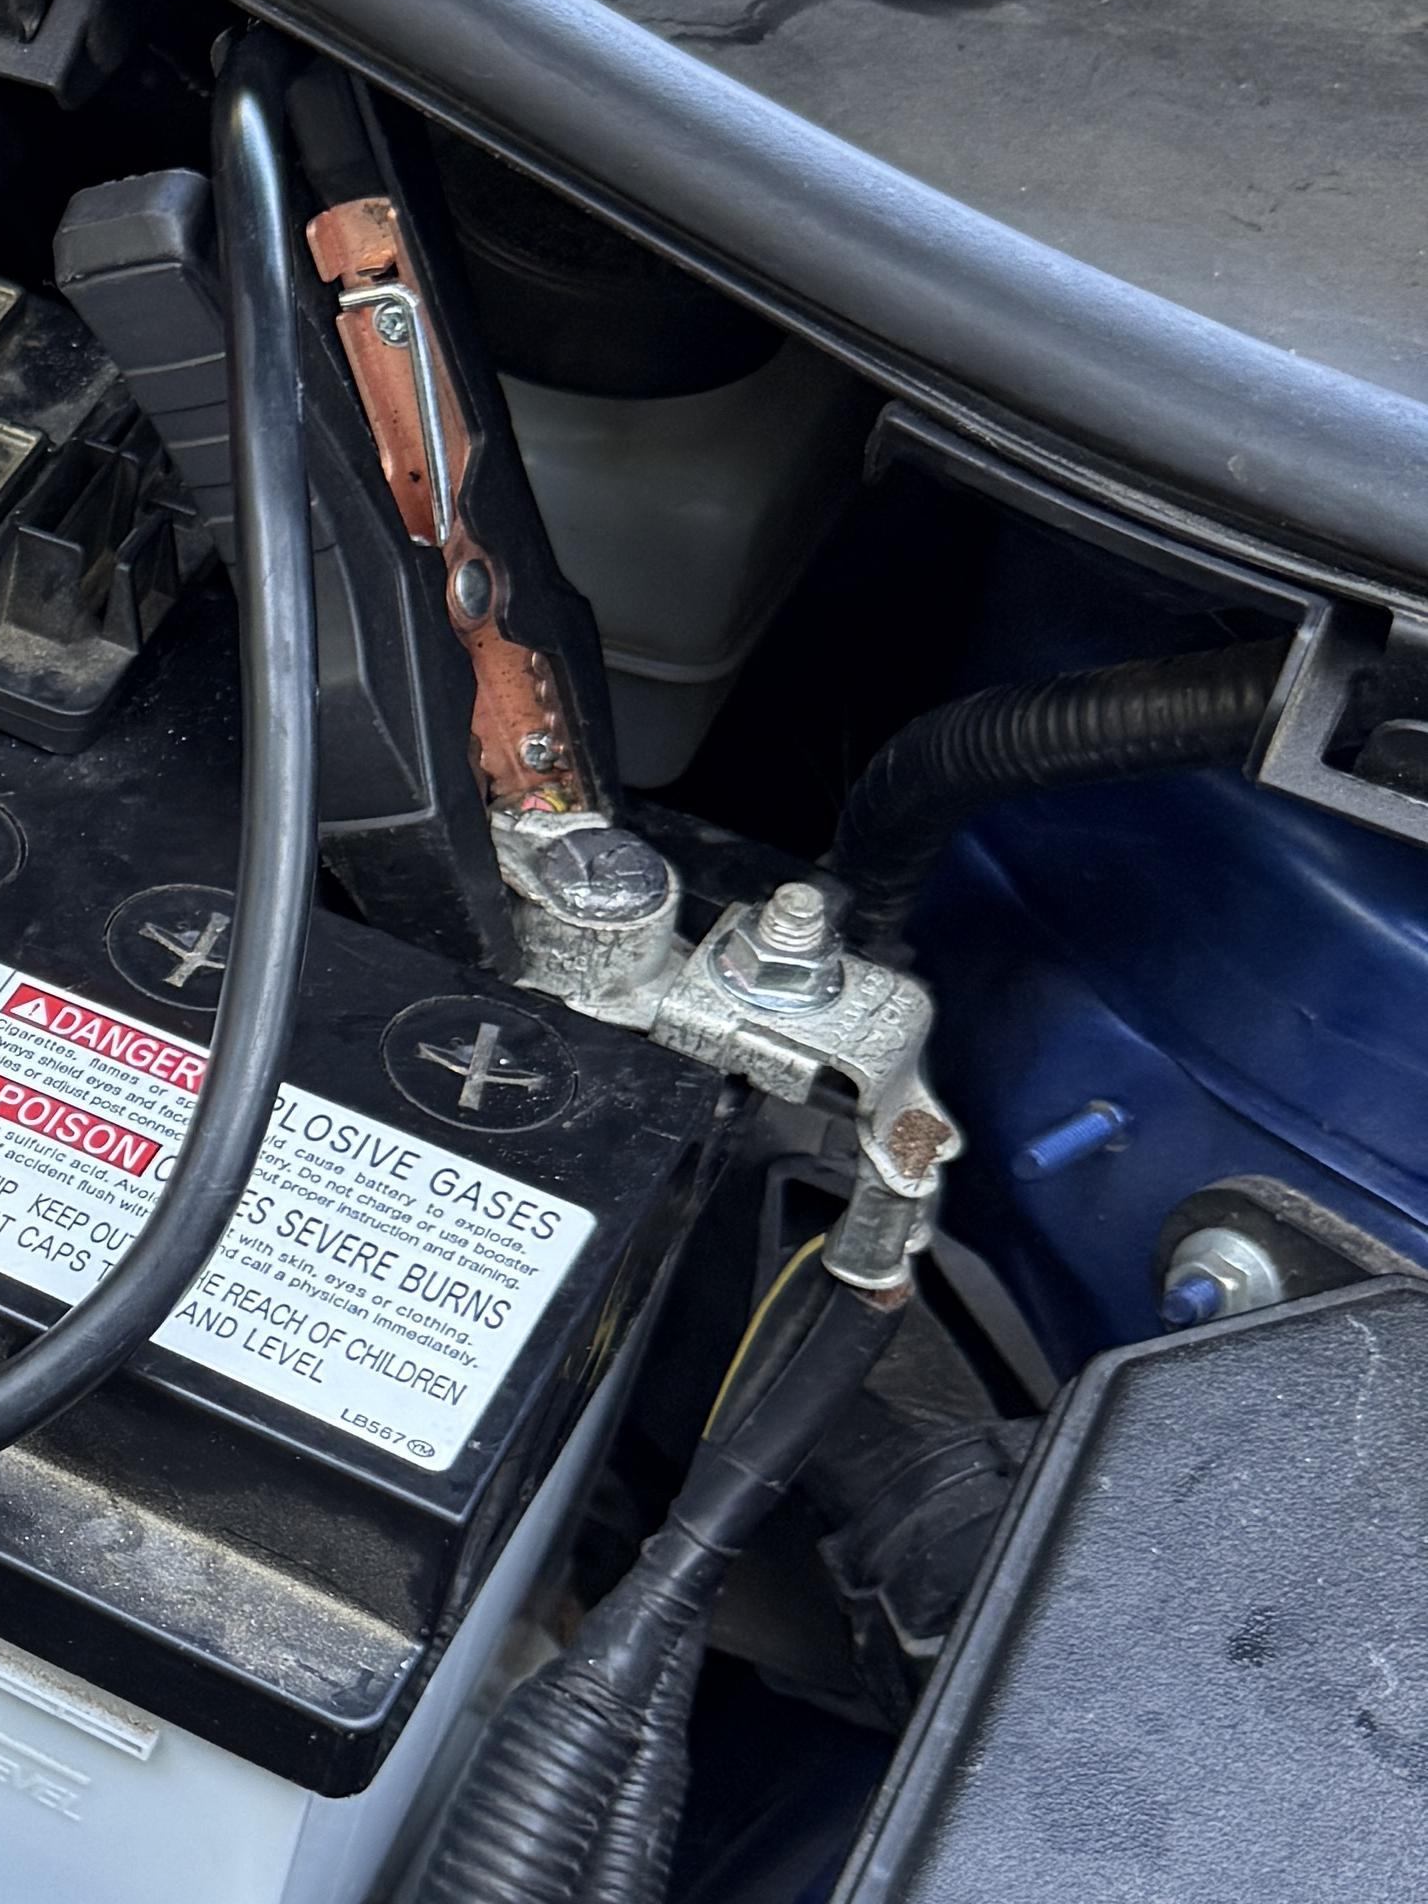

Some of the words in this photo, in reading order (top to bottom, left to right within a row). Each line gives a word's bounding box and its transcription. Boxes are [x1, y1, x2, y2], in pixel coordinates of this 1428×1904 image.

[37, 1056, 86, 1080] shield
[85, 1075, 123, 1096] eyes
[124, 1092, 158, 1111] and
[48, 1006, 207, 1089] DANGER
[87, 1057, 141, 1086] flames
[42, 1076, 91, 1101] adjust
[88, 1095, 127, 1117] post
[4, 1131, 67, 1163] sulfuric
[69, 1159, 109, 1184] acid.
[4, 1149, 76, 1186] accident
[76, 1179, 116, 1205] flush
[26, 1192, 91, 1232] KEEP
[279, 1179, 336, 1209] proper
[335, 1201, 421, 1247] instruction
[421, 1241, 457, 1262] and
[456, 1254, 520, 1291] training.
[293, 1148, 346, 1176] cause
[353, 1171, 418, 1207] battery
[454, 1217, 527, 1255] explode.
[324, 1179, 354, 1199] not
[356, 1193, 413, 1224] charge
[438, 1229, 470, 1249] use
[472, 1241, 540, 1277] booster
[429, 1167, 562, 1240] GASES
[17, 1225, 92, 1273] CAPS
[276, 1209, 400, 1282] SEVERE
[397, 1262, 512, 1330] BURNS
[238, 1233, 274, 1257] with
[324, 1273, 368, 1299] eyes
[395, 1305, 473, 1346] clothing.
[240, 1255, 273, 1275] call
[287, 1277, 370, 1320] physician
[372, 1312, 479, 1369] immediately.
[174, 1300, 239, 1339] AND
[242, 1327, 325, 1384] LEVEL
[220, 1281, 310, 1336] REACH
[308, 1321, 348, 1349] OF
[345, 1338, 469, 1407] CHILDREN
[339, 1407, 407, 1445] LB567
